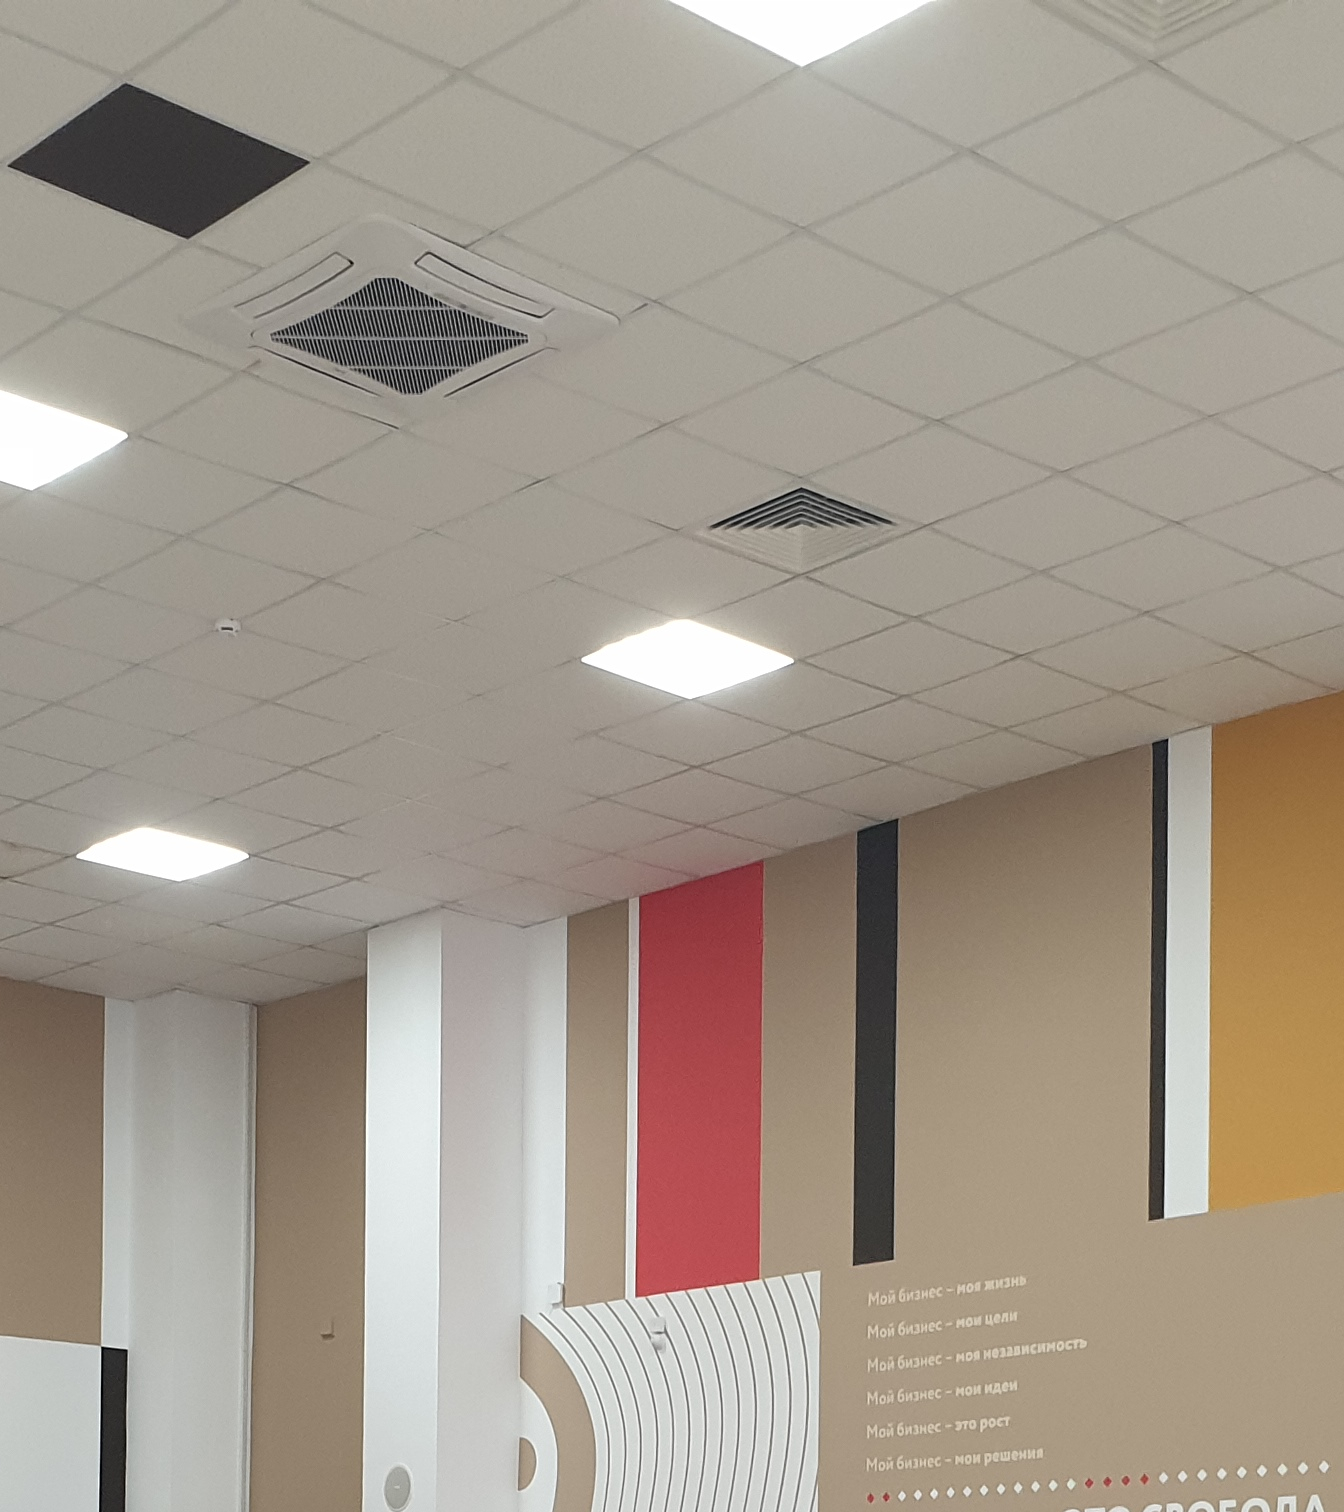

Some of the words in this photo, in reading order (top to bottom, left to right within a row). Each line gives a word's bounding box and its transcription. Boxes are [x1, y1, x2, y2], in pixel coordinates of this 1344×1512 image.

[867, 1289, 896, 1307] Мой
[899, 1286, 943, 1302] бизнес
[956, 1281, 981, 1295] моя
[984, 1275, 1027, 1292] жизнь
[867, 1322, 895, 1340] Мой
[898, 1319, 943, 1336] бизнес
[956, 1315, 982, 1329] мои
[985, 1310, 1018, 1327] цели
[867, 1356, 895, 1373] Мой
[897, 1353, 942, 1370] бизнес
[956, 1349, 981, 1363] моя
[983, 1338, 1088, 1361] независимость
[866, 1389, 895, 1406] Мой
[897, 1387, 942, 1403] бизнес
[955, 1384, 981, 1398] мои
[984, 1380, 1018, 1395] идеи
[866, 1423, 894, 1439] Мой
[896, 1420, 942, 1437] бизнес
[954, 1418, 977, 1432] это
[979, 1416, 1011, 1433] рост
[866, 1456, 894, 1473] Мой
[896, 1454, 942, 1471] бизнес
[955, 1452, 981, 1466] мои
[984, 1447, 1044, 1467] решения
